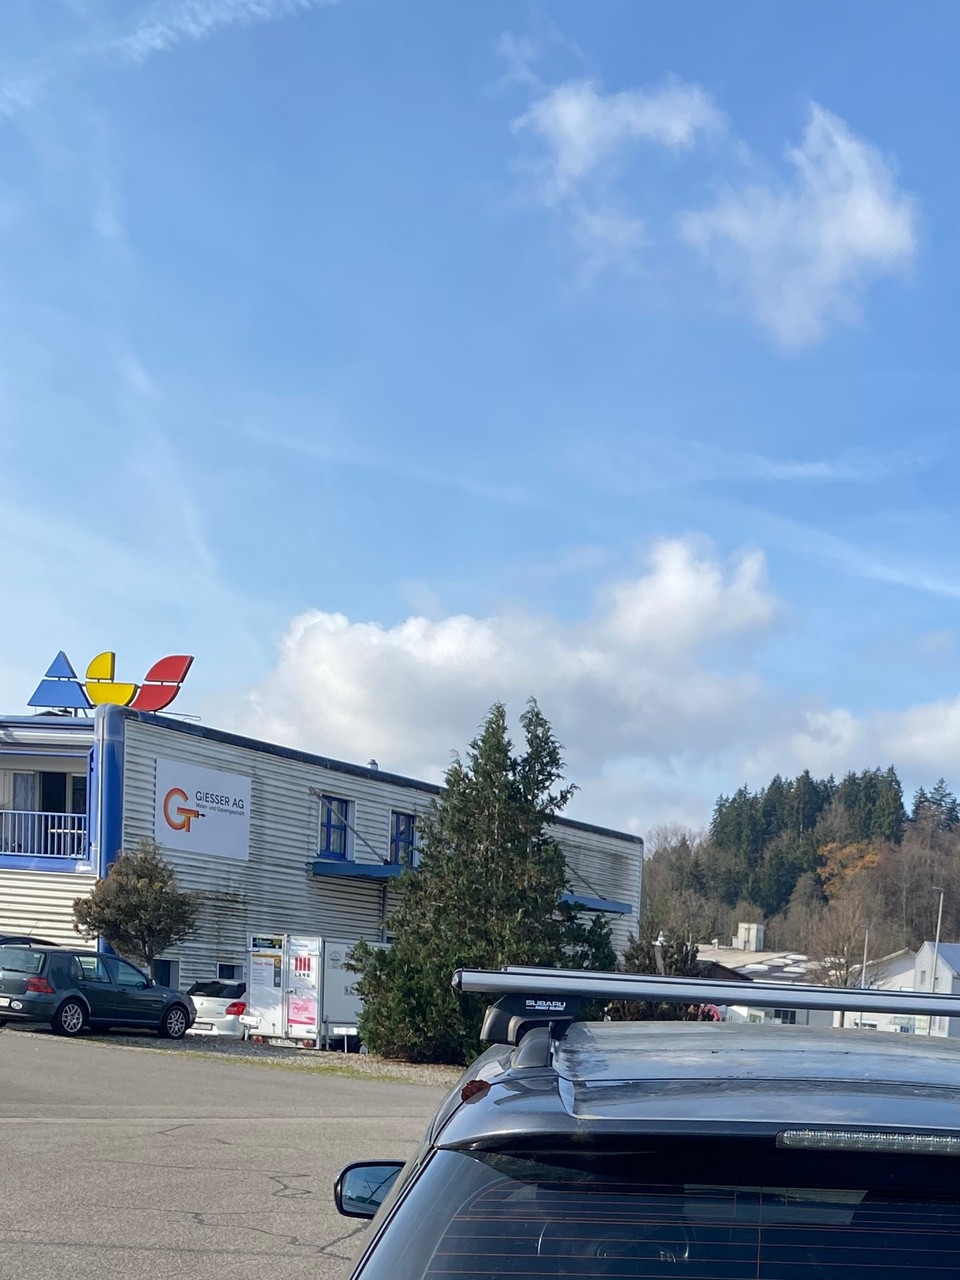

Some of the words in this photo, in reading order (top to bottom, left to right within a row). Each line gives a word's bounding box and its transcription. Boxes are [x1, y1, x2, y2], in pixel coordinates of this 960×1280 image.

[195, 790, 230, 807] GIESSER
[232, 798, 244, 809] AG
[525, 1000, 566, 1008] SUBARU
